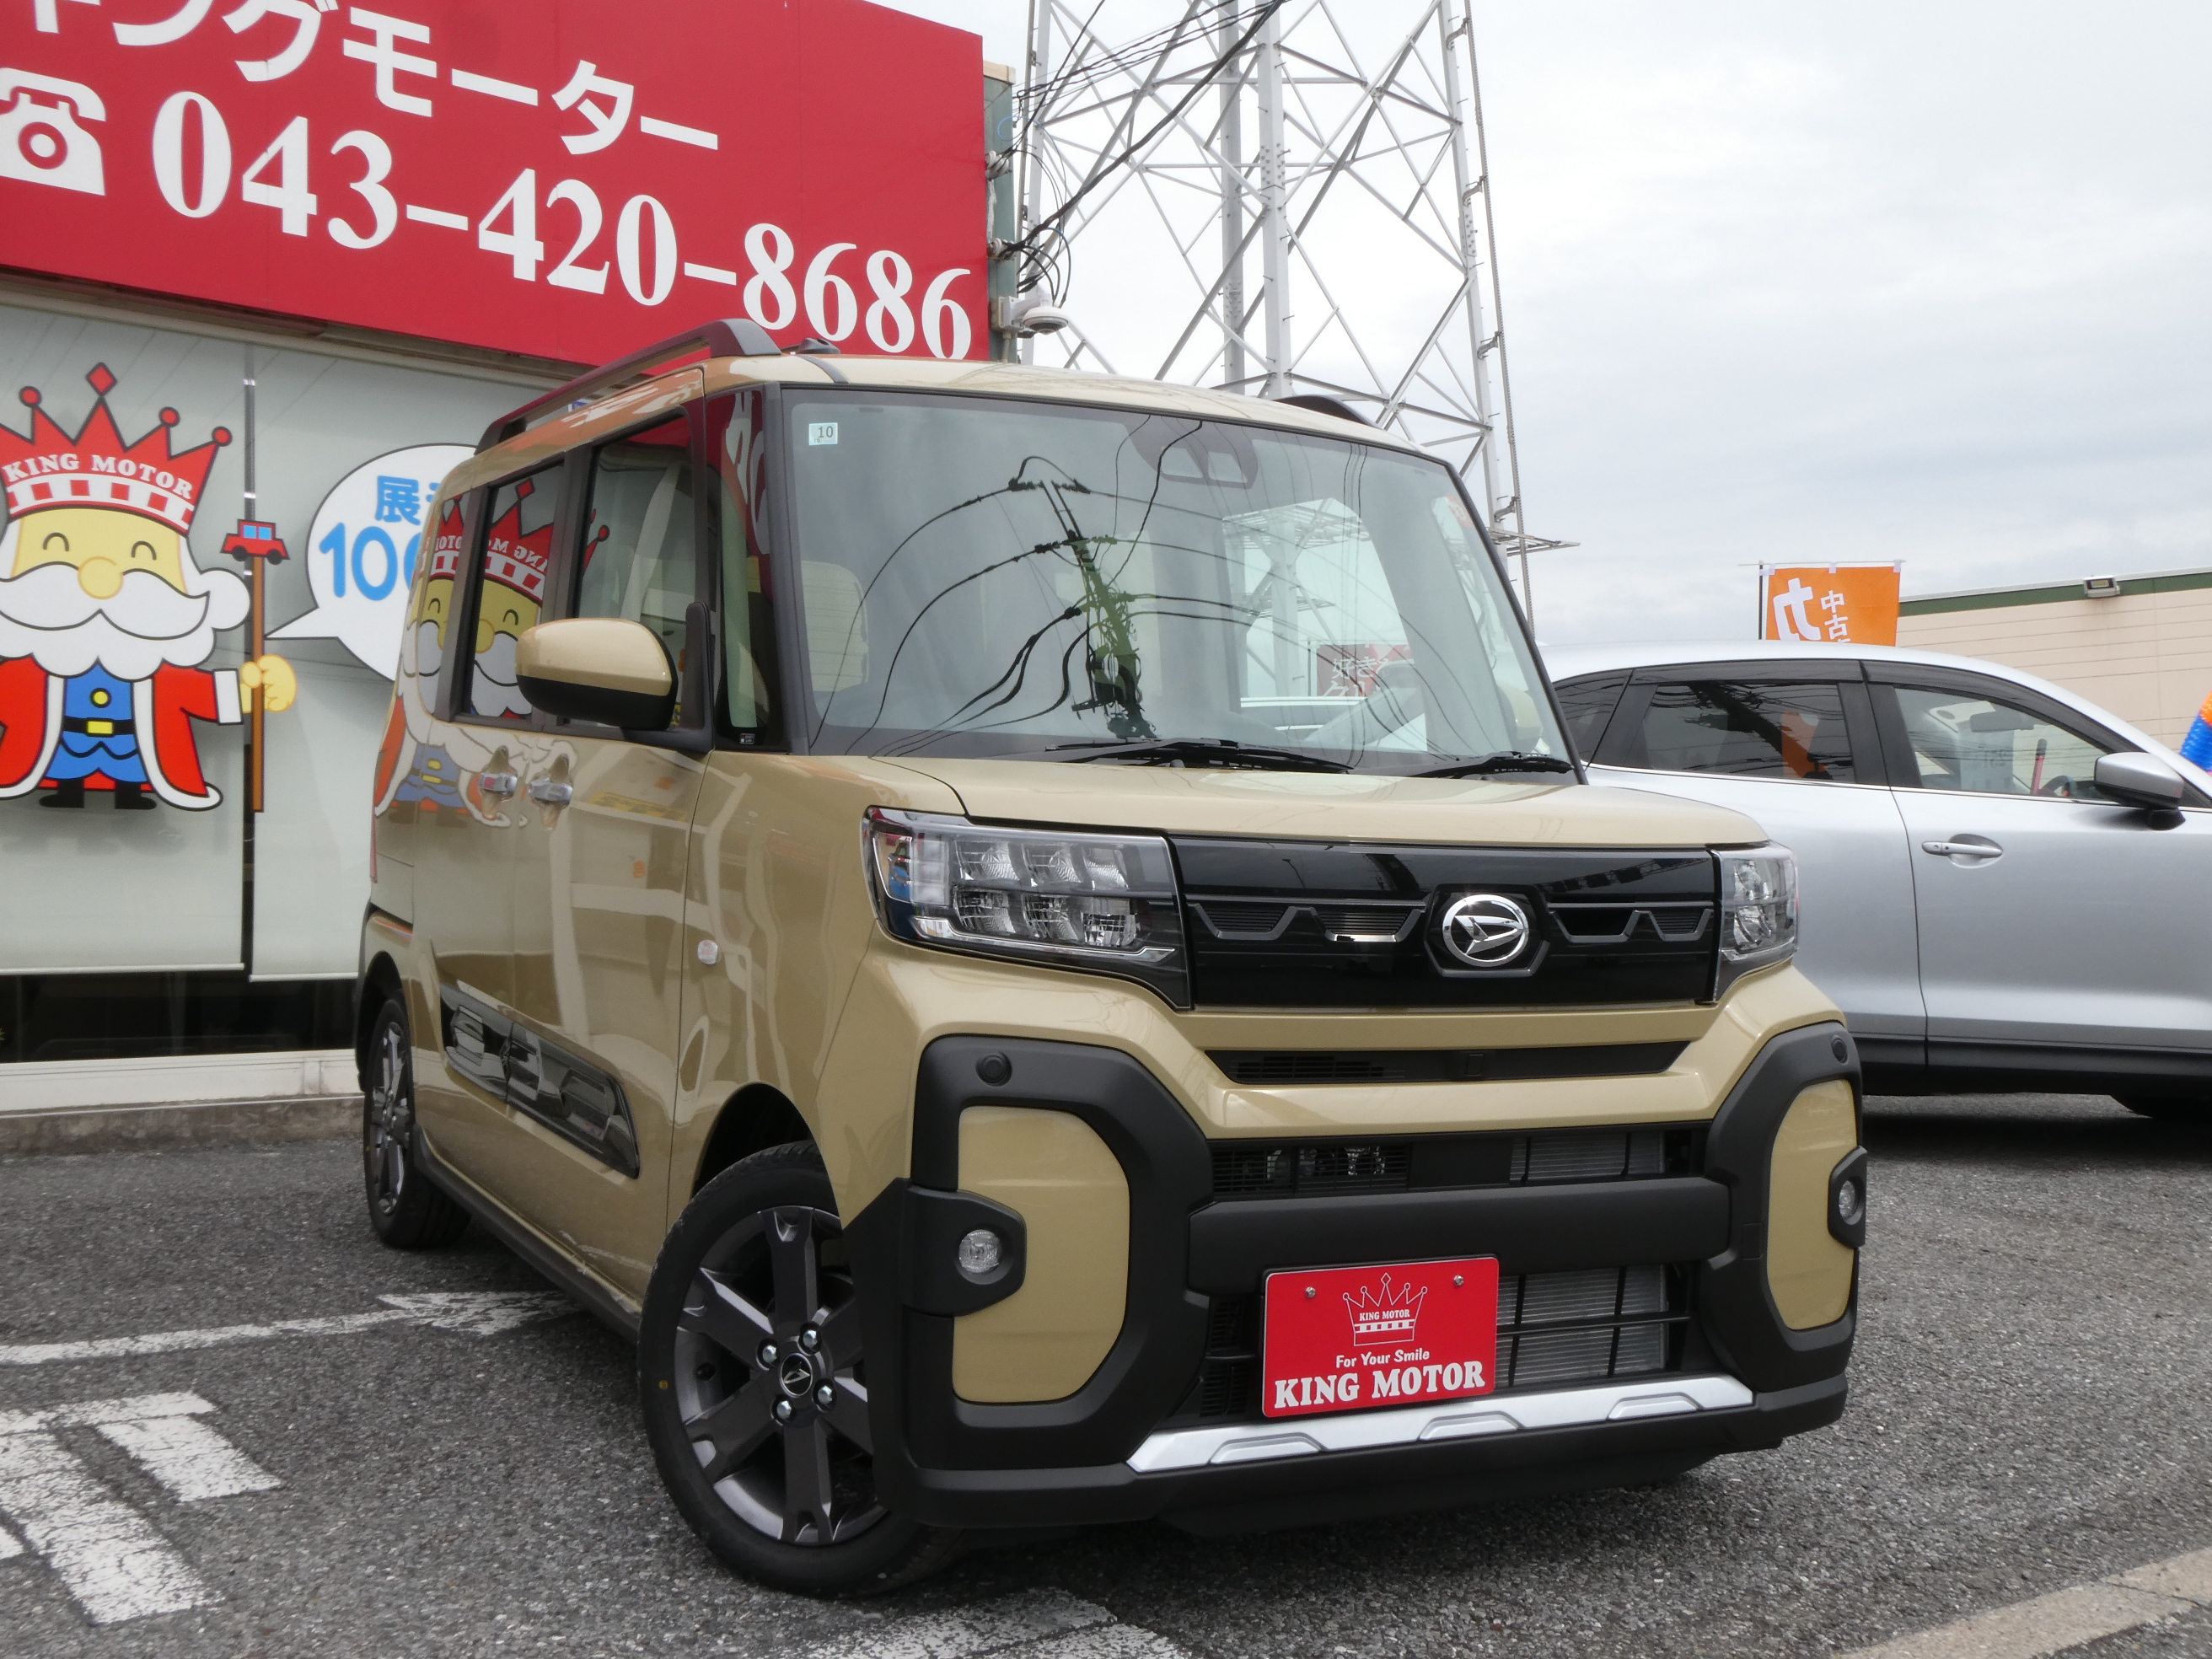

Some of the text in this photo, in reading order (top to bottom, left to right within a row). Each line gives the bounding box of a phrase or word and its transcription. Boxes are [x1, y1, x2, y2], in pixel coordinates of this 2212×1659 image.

[152, 90, 972, 361] 043-420-8686
[818, 426, 834, 438] 10
[3, 453, 194, 500] KING MOTOR
[1820, 589, 1851, 644] 中古
[1359, 1308, 1410, 1322] KING MOTOR
[1335, 1347, 1430, 1368] For Your Smile
[1274, 1360, 1485, 1409] KING MOTOR
